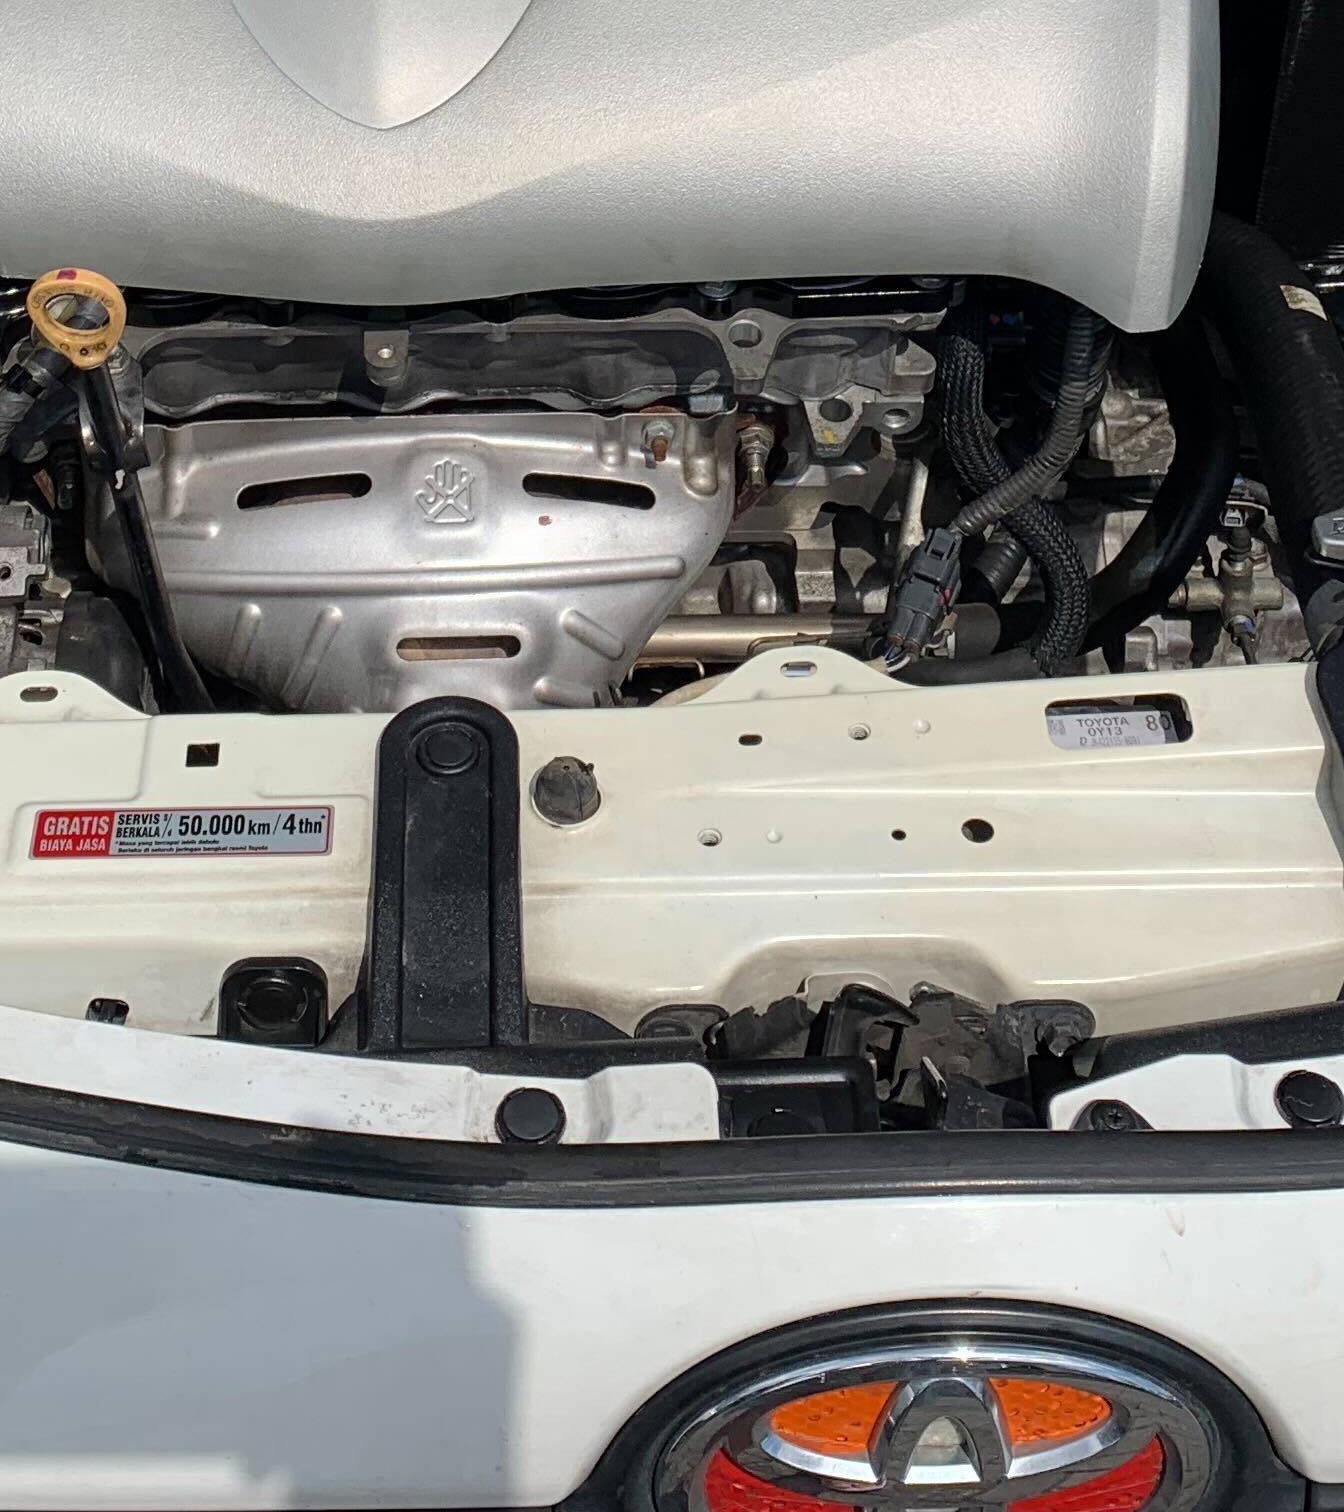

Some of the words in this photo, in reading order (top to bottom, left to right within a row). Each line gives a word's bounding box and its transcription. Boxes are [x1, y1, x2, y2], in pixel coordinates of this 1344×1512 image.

[1076, 716, 1131, 728] TOYOTA
[43, 814, 110, 837] GRATIS
[117, 813, 161, 826] SERVIS
[178, 814, 246, 837] 50.000
[115, 825, 161, 838] BERKALA
[39, 838, 73, 852] BIAYA
[75, 837, 106, 851] JASA
